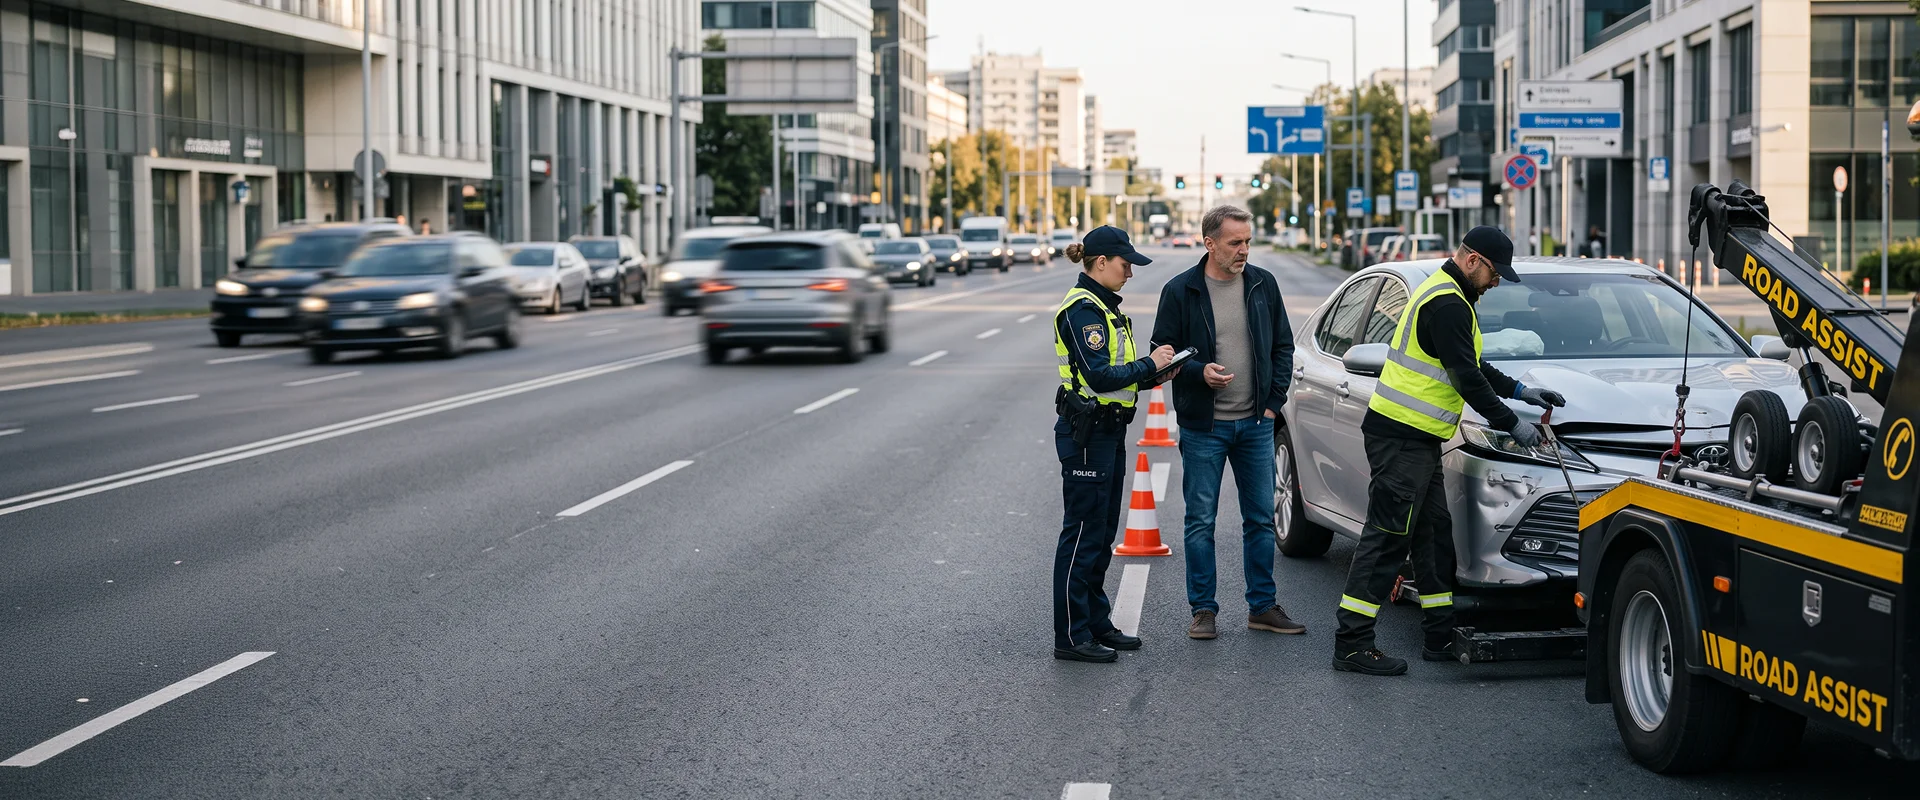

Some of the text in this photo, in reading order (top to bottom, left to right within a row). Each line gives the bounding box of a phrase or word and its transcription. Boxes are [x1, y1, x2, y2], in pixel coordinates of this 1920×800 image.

[1742, 253, 1884, 391] ROAD ASSIST
[1072, 469, 1097, 478] POLICE
[1740, 644, 1888, 733] ROAD ASSIST
